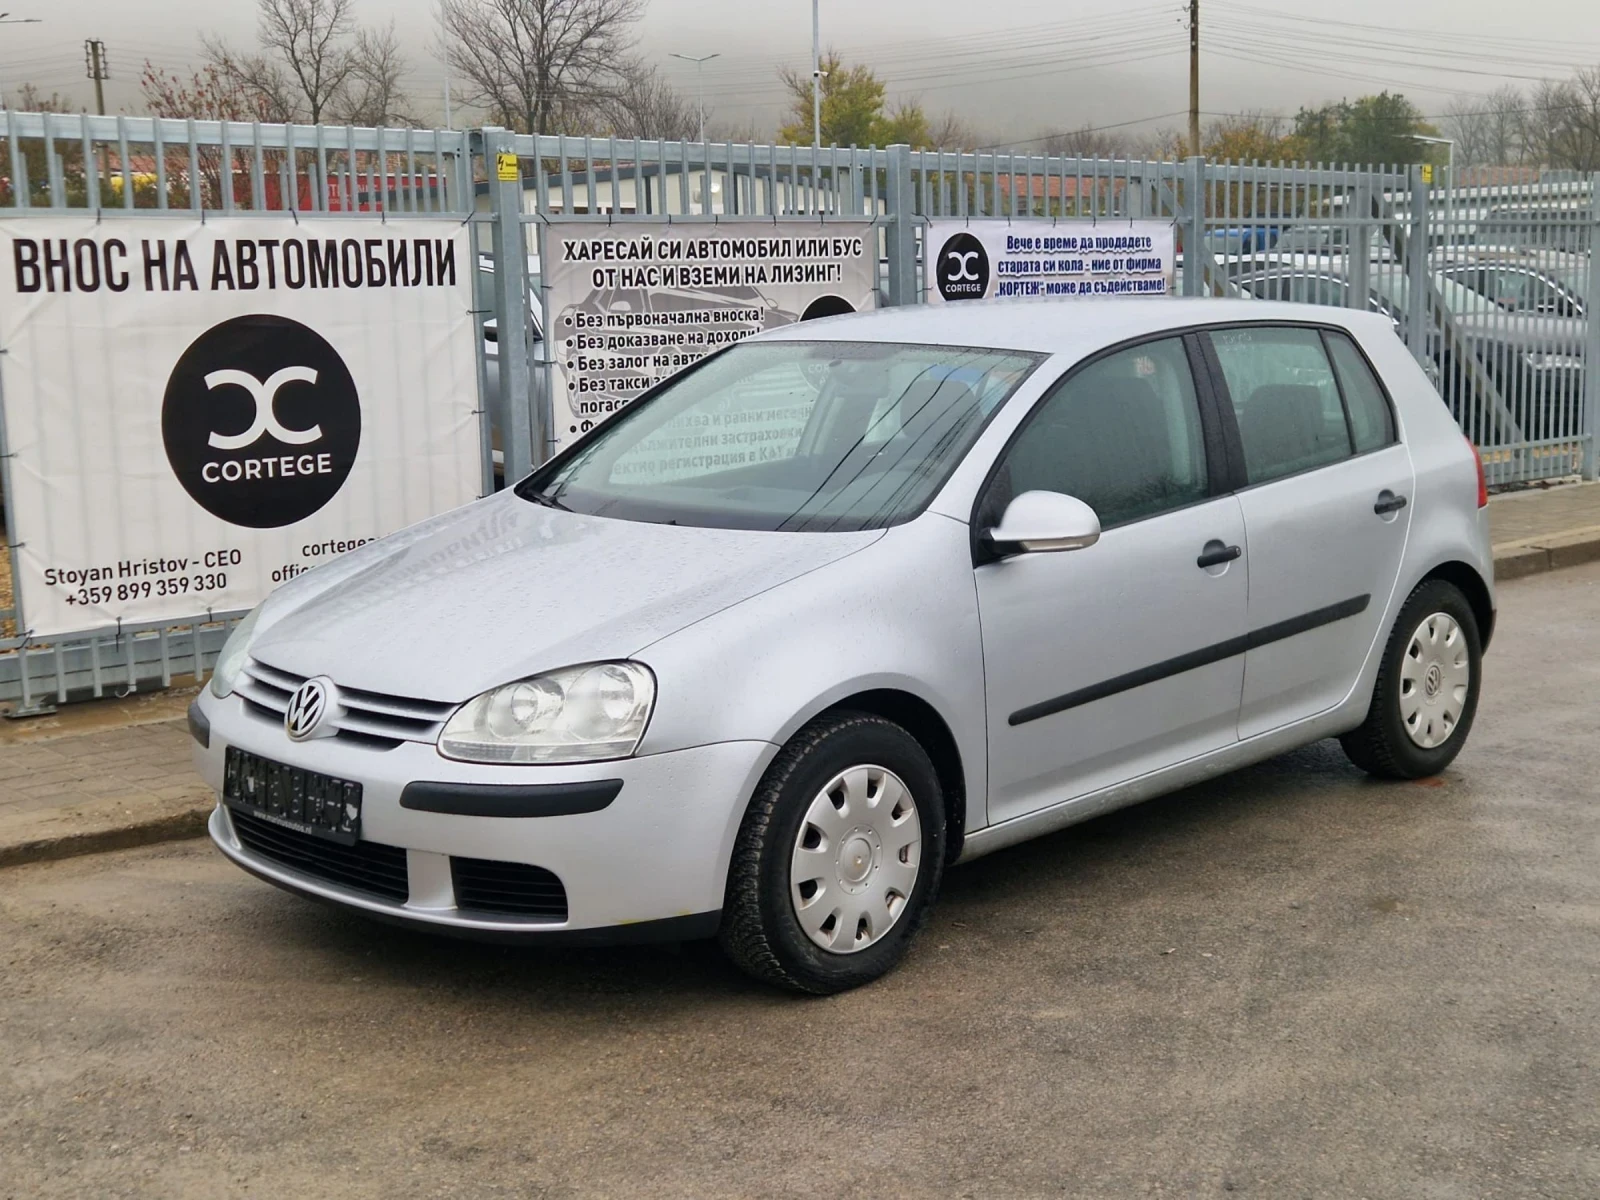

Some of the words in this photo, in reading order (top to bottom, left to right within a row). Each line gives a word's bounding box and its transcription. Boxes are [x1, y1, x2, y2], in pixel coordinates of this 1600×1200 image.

[564, 236, 653, 260] ХАРЕСАЙ
[657, 240, 681, 259] СИ
[685, 239, 791, 259] АВТОМОБИЛ
[796, 239, 829, 257] ИЛИ
[833, 238, 862, 256] БУС
[1006, 235, 1033, 250] Вече
[1035, 237, 1041, 250] е
[1044, 237, 1077, 251] време
[1080, 237, 1093, 250] да
[1095, 236, 1152, 251] продадете
[13, 238, 129, 293] ВНОС
[141, 239, 199, 292] НА
[211, 239, 457, 290] АВТОМОБИЛИ
[592, 268, 616, 288] ОТ
[621, 267, 658, 287] НАС
[663, 267, 675, 286] И
[679, 266, 740, 286] ВЗЕМИ
[745, 265, 767, 284] НА
[770, 263, 841, 283] ЛИЗИНГ!
[998, 260, 1040, 274] старата
[1043, 260, 1056, 272] си
[1058, 259, 1083, 272] кола
[1091, 259, 1111, 271] ние
[1113, 259, 1124, 271] от
[1126, 257, 1162, 271] фирма
[945, 283, 981, 294] CORTEGE
[1046, 282, 1076, 294] може
[1079, 281, 1092, 295] да
[1094, 277, 1165, 295] съдействаме!
[576, 312, 603, 328] Без
[607, 311, 710, 329] първоначална
[713, 306, 764, 322] вноска!
[577, 334, 604, 350] Без
[608, 333, 685, 350] доказване
[688, 332, 704, 344] на
[578, 356, 605, 371] Без
[609, 355, 650, 369] залог
[653, 354, 669, 367] на
[579, 377, 606, 392] Без
[609, 377, 650, 391] такси
[201, 453, 332, 483] CORTEGE
[44, 566, 113, 586] Stoyan
[118, 558, 188, 578] Hristov
[204, 549, 241, 568] CEO
[65, 585, 113, 605] +359
[117, 581, 151, 601] 899
[156, 577, 189, 596] 359
[194, 573, 227, 591] 330
